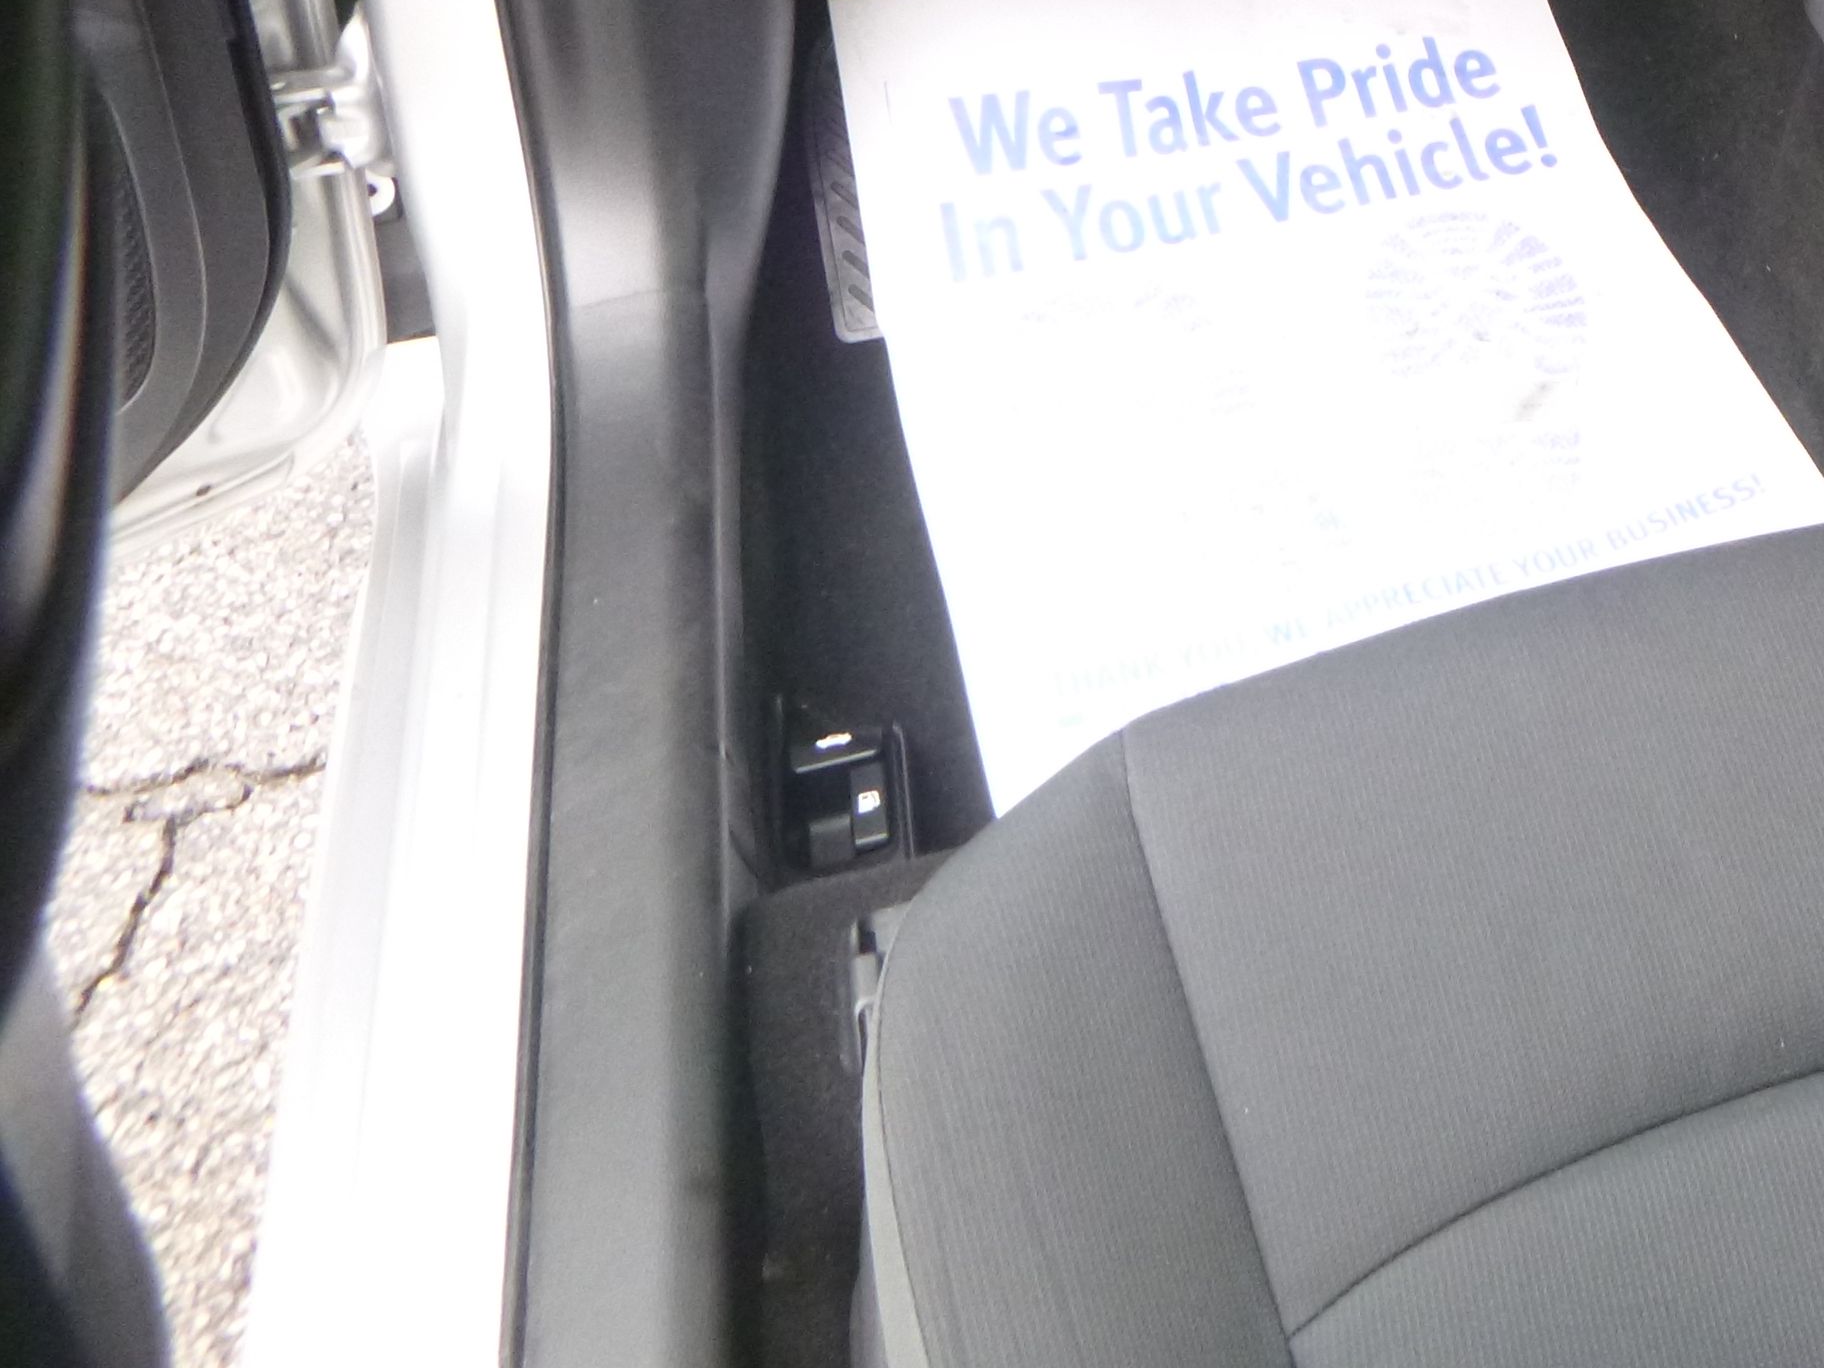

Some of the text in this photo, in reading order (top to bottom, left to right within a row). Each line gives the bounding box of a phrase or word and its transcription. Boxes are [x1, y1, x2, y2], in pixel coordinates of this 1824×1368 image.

[939, 106, 1559, 283] In Your Vehicle!
[948, 37, 1503, 176] We Take Pride
[1052, 652, 1165, 697] THANK
[1262, 617, 1311, 649] WE
[1325, 562, 1509, 633] APPRECIATE
[1511, 535, 1599, 581] YOUR
[1604, 472, 1768, 553] BUSINESS!
